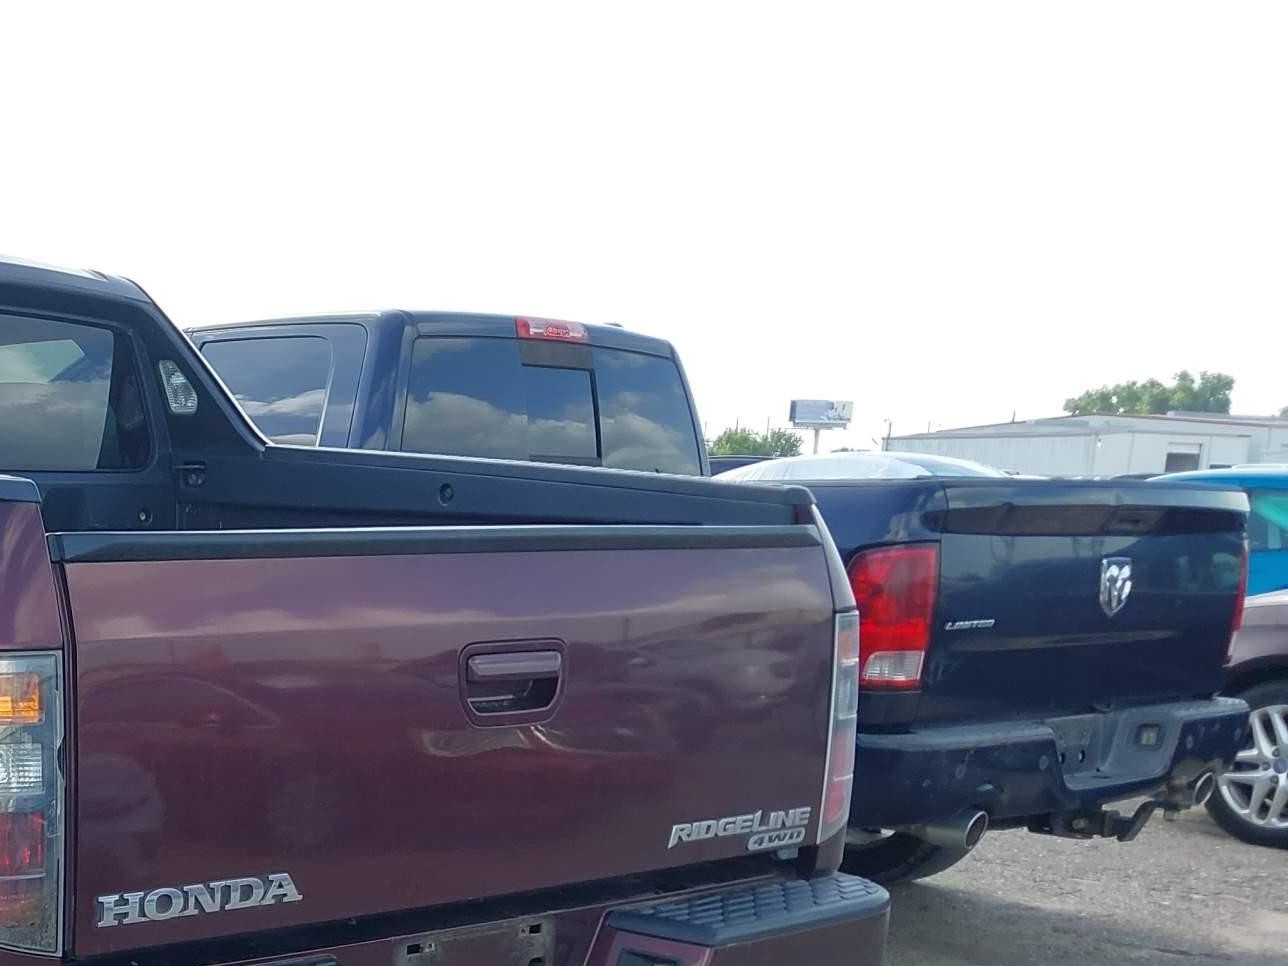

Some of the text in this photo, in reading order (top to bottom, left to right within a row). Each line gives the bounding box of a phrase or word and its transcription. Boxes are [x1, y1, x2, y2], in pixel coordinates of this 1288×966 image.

[668, 806, 812, 849] RIDGELINE
[750, 828, 805, 849] 4WD
[96, 872, 304, 928] HONDA
